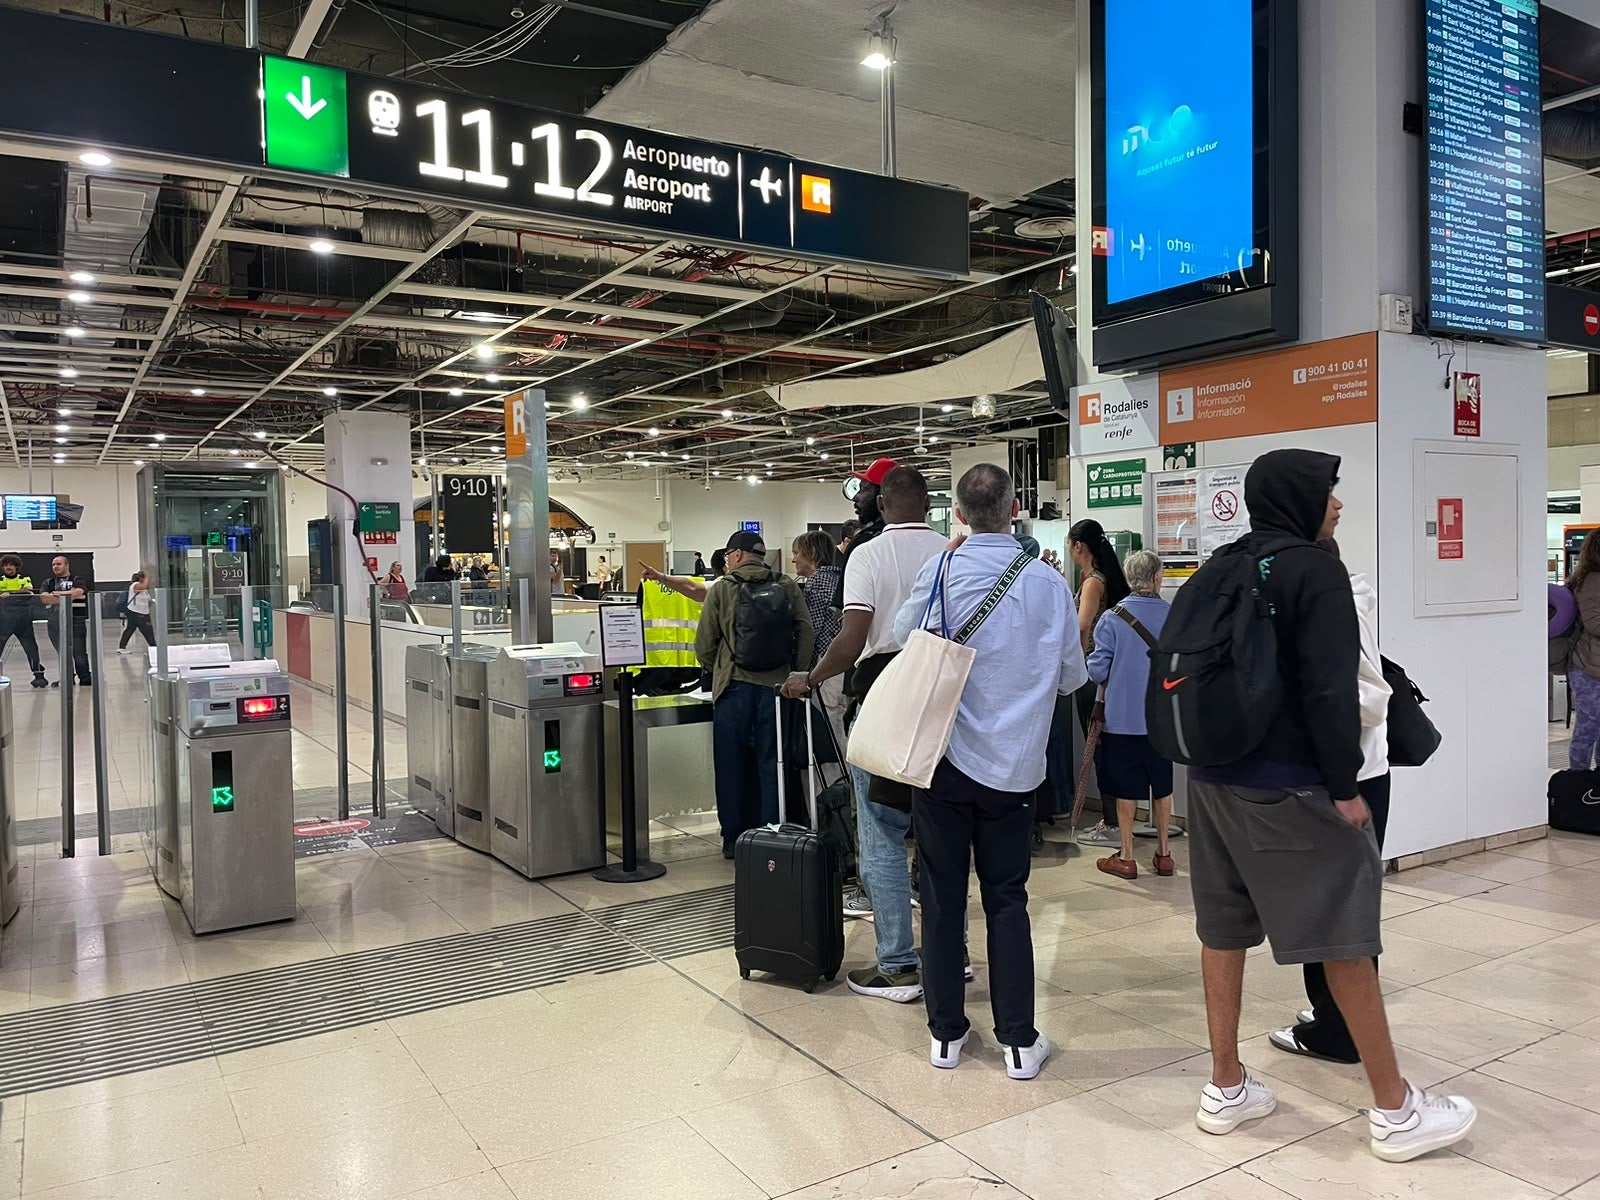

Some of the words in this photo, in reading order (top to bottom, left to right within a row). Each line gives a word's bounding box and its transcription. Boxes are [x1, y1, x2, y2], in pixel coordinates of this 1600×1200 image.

[622, 138, 730, 178] Aeropuerto
[1136, 162, 1163, 177] Aquest
[1164, 154, 1184, 166] futur
[1197, 141, 1218, 155] futur
[622, 167, 710, 203] Aeroport
[812, 182, 830, 206] R
[624, 194, 673, 216] AIRPORT
[1308, 366, 1325, 376] 900
[1328, 363, 1338, 372] 41
[1342, 361, 1354, 370] 00
[1357, 358, 1368, 368] 41
[1197, 378, 1251, 396] Informació
[1333, 380, 1367, 390] @rodalies
[1198, 394, 1245, 407] Información
[1336, 390, 1367, 400] Rodalies
[1088, 398, 1100, 417] R
[1104, 399, 1148, 415] Rodalies
[1198, 407, 1245, 419] Information
[513, 400, 525, 435] R
[1111, 412, 1137, 422] Catalunya
[1105, 425, 1132, 440] renfe
[1004, 568, 1016, 583] TED
[983, 584, 1005, 611] BAKER
